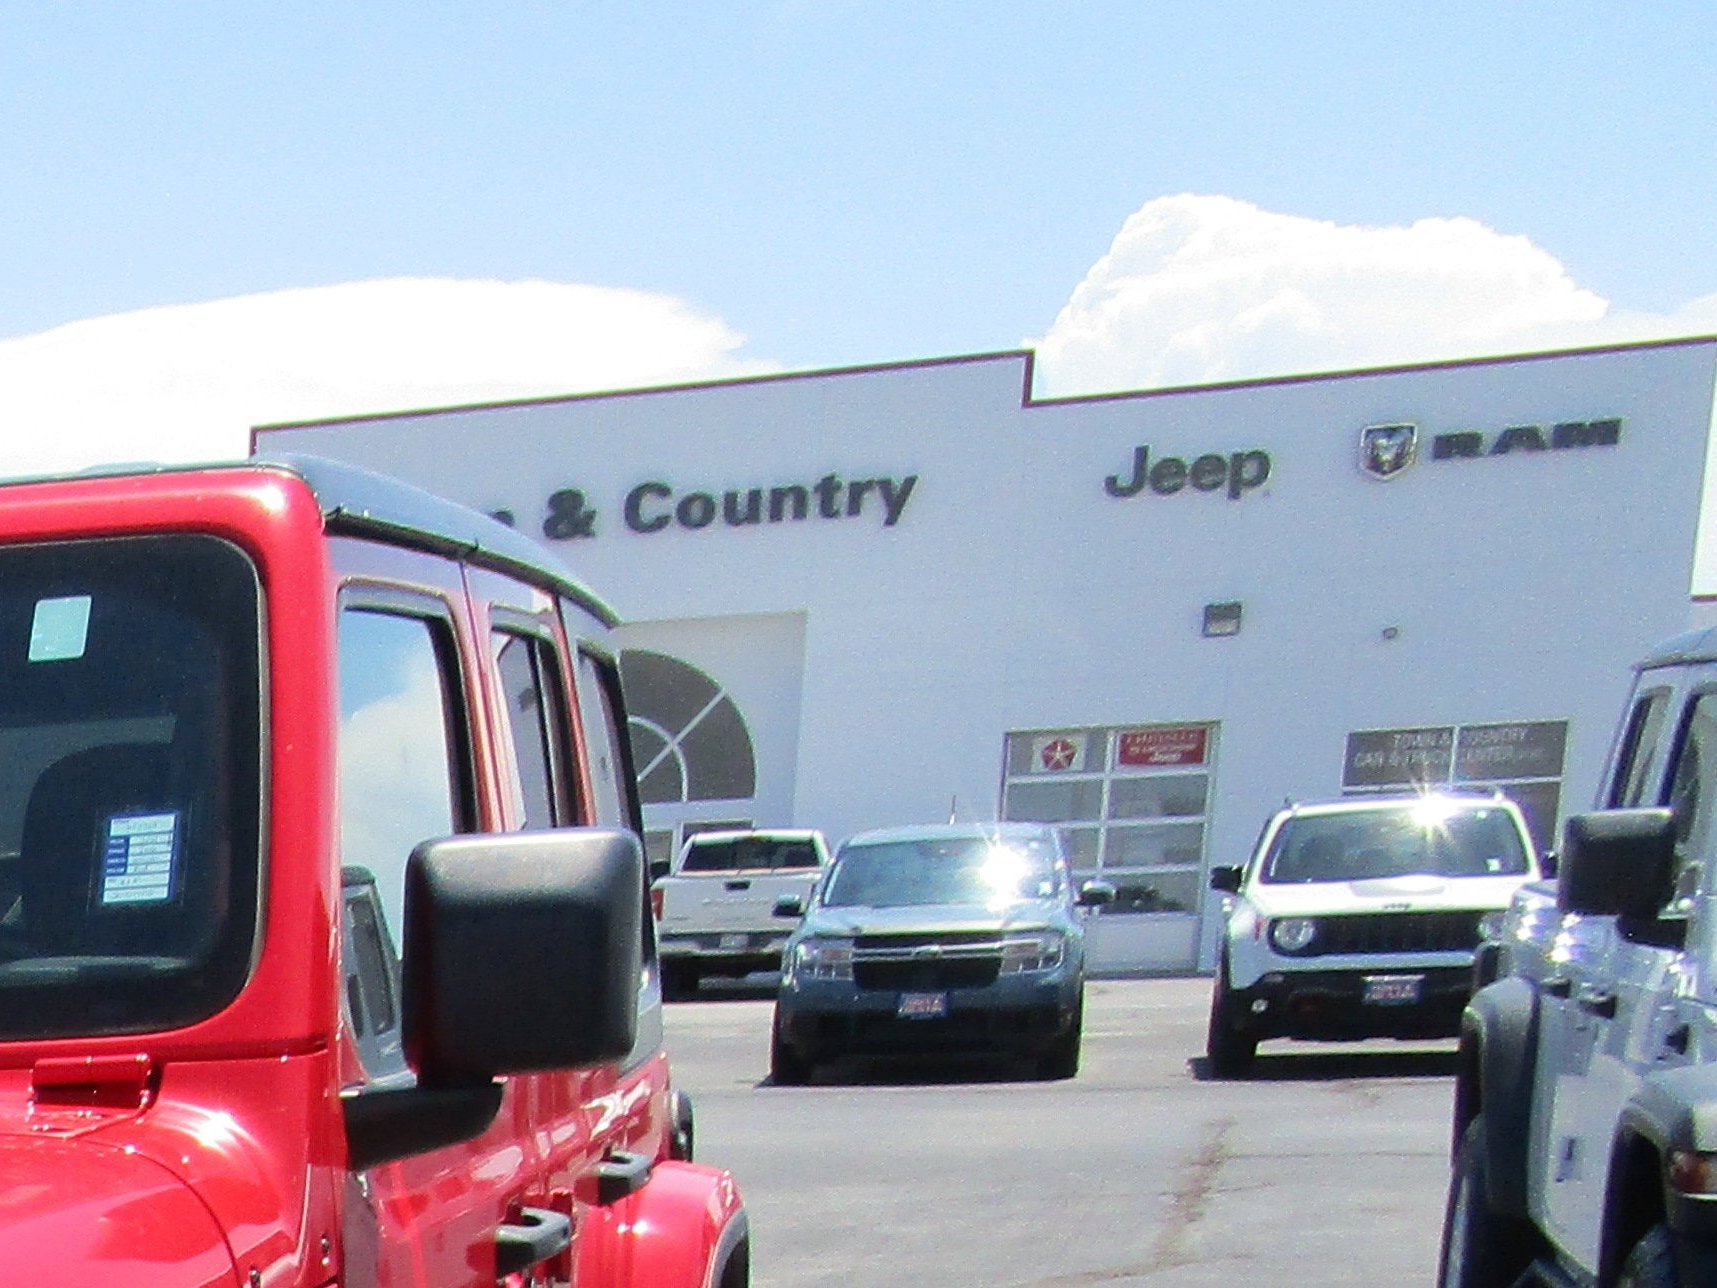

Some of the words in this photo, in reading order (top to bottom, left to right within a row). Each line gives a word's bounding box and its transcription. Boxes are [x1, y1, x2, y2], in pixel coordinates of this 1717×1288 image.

[1431, 417, 1625, 461] RAM
[1103, 443, 1273, 501] Jeep
[542, 486, 597, 541] &
[622, 470, 920, 534] Country
